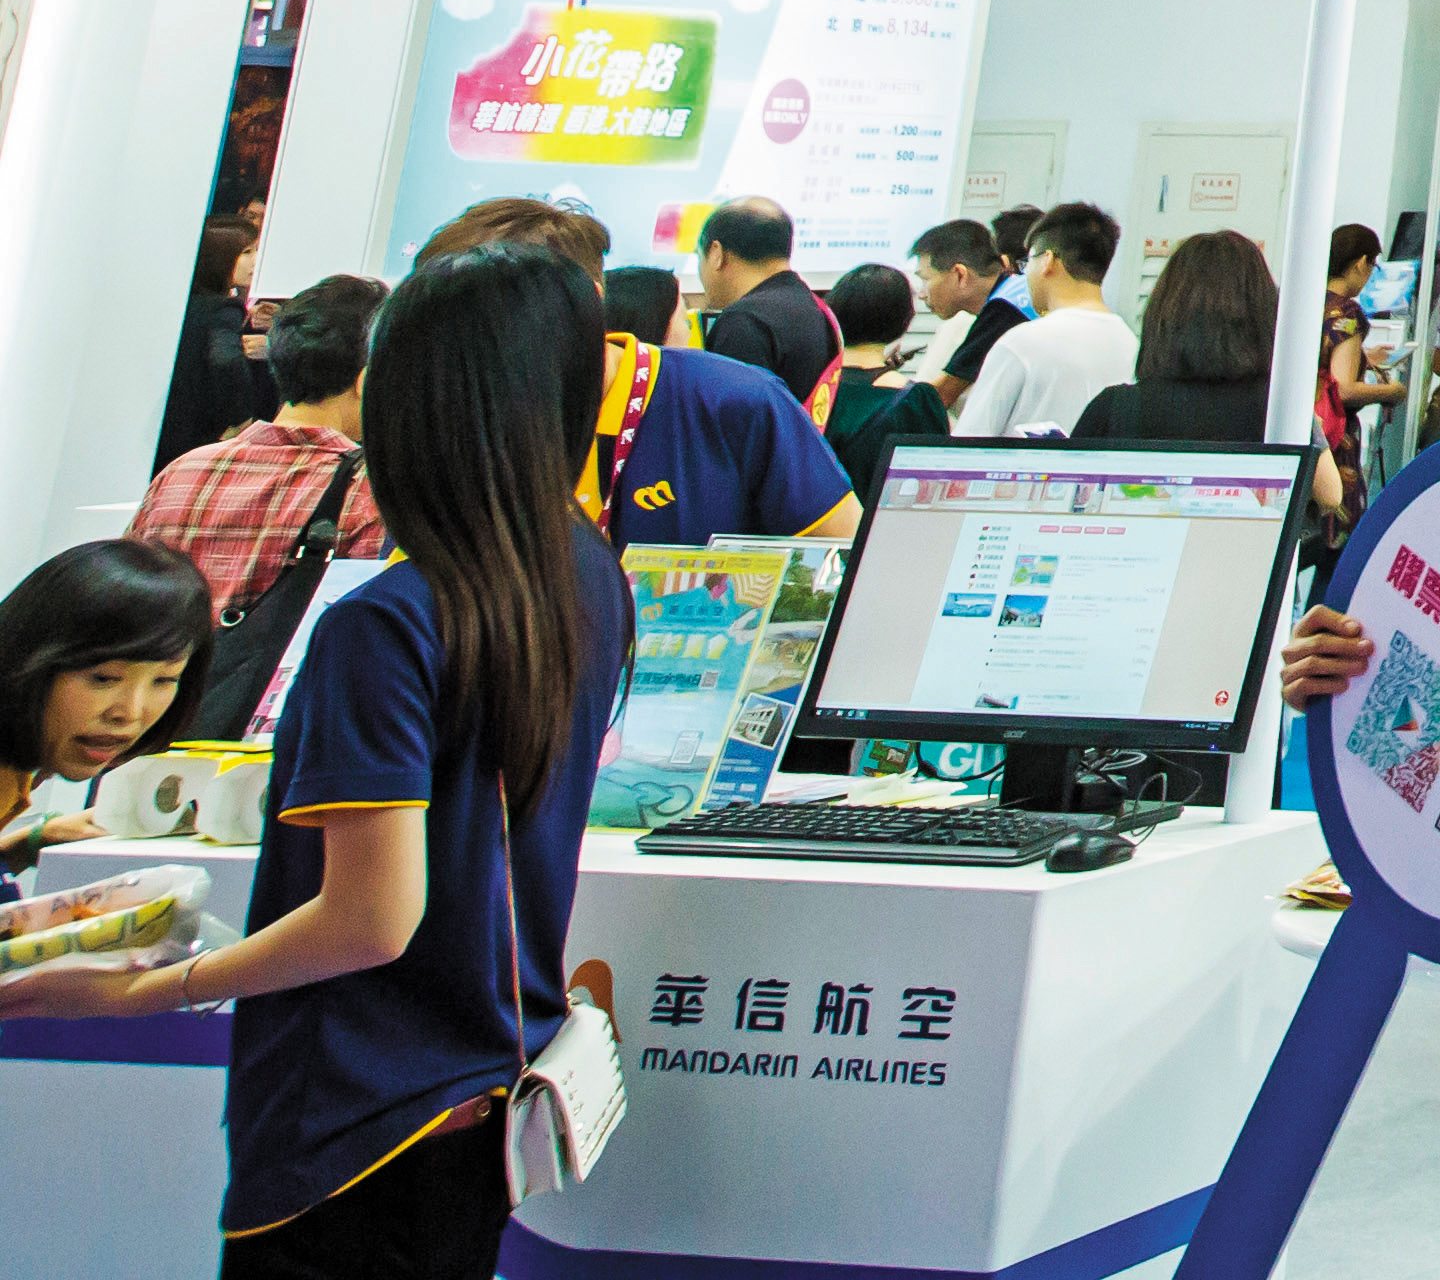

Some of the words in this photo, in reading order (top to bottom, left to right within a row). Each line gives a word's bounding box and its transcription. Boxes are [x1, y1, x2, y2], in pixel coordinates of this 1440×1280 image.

[886, 17, 930, 37] 8,134
[649, 972, 958, 1041] 華信航空
[639, 1047, 799, 1078] MANDARIN
[810, 1056, 949, 1086] AIRLINES
